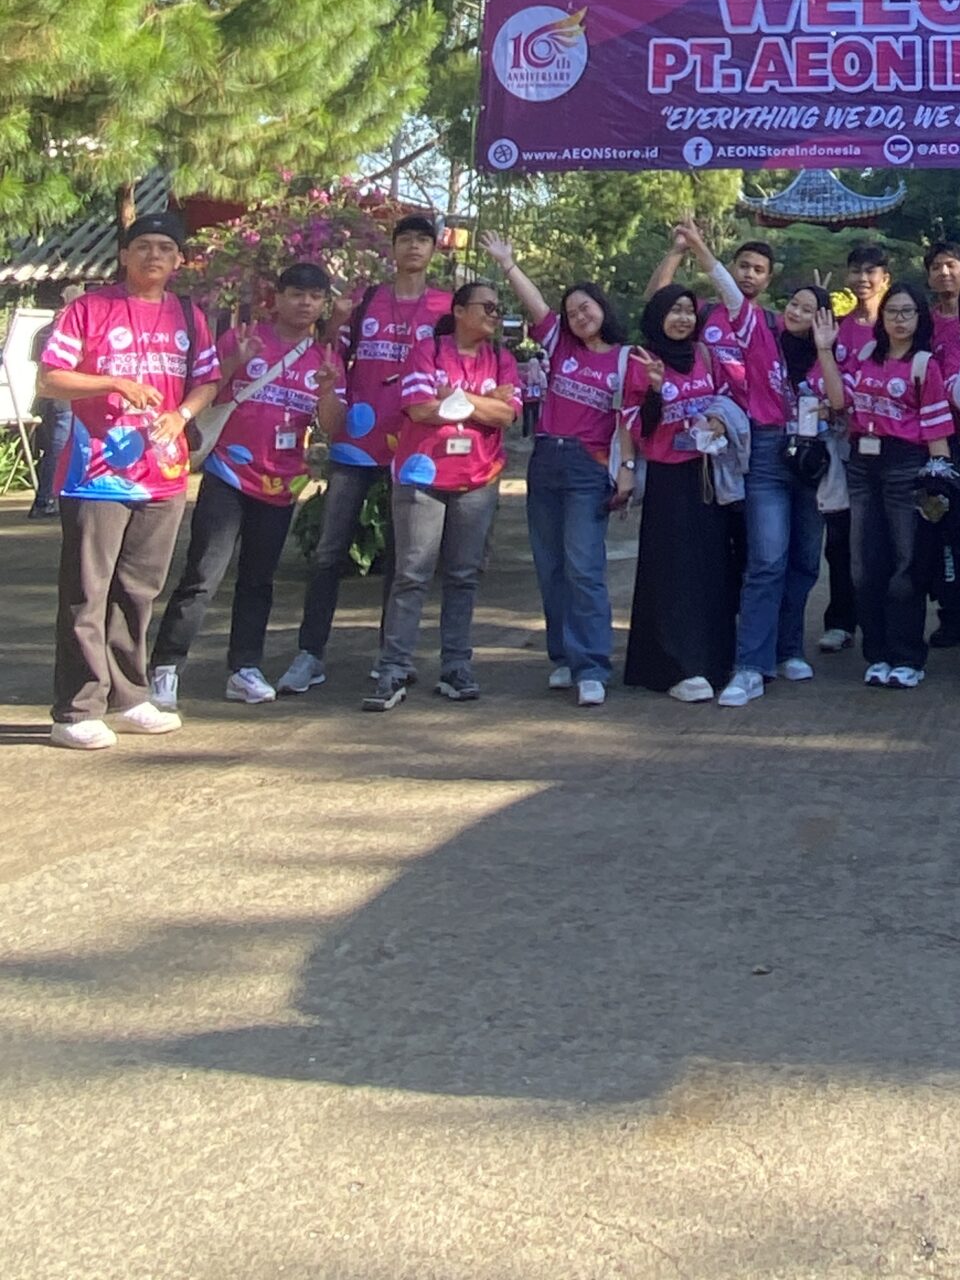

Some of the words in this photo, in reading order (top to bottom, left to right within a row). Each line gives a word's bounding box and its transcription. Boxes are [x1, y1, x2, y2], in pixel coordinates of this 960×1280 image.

[745, 36, 922, 92] AEON
[824, 106, 866, 130] WE
[913, 105, 956, 129] WE
[521, 146, 659, 161] www.AEONStore.id
[717, 144, 861, 158] AEONStoreIndonesia
